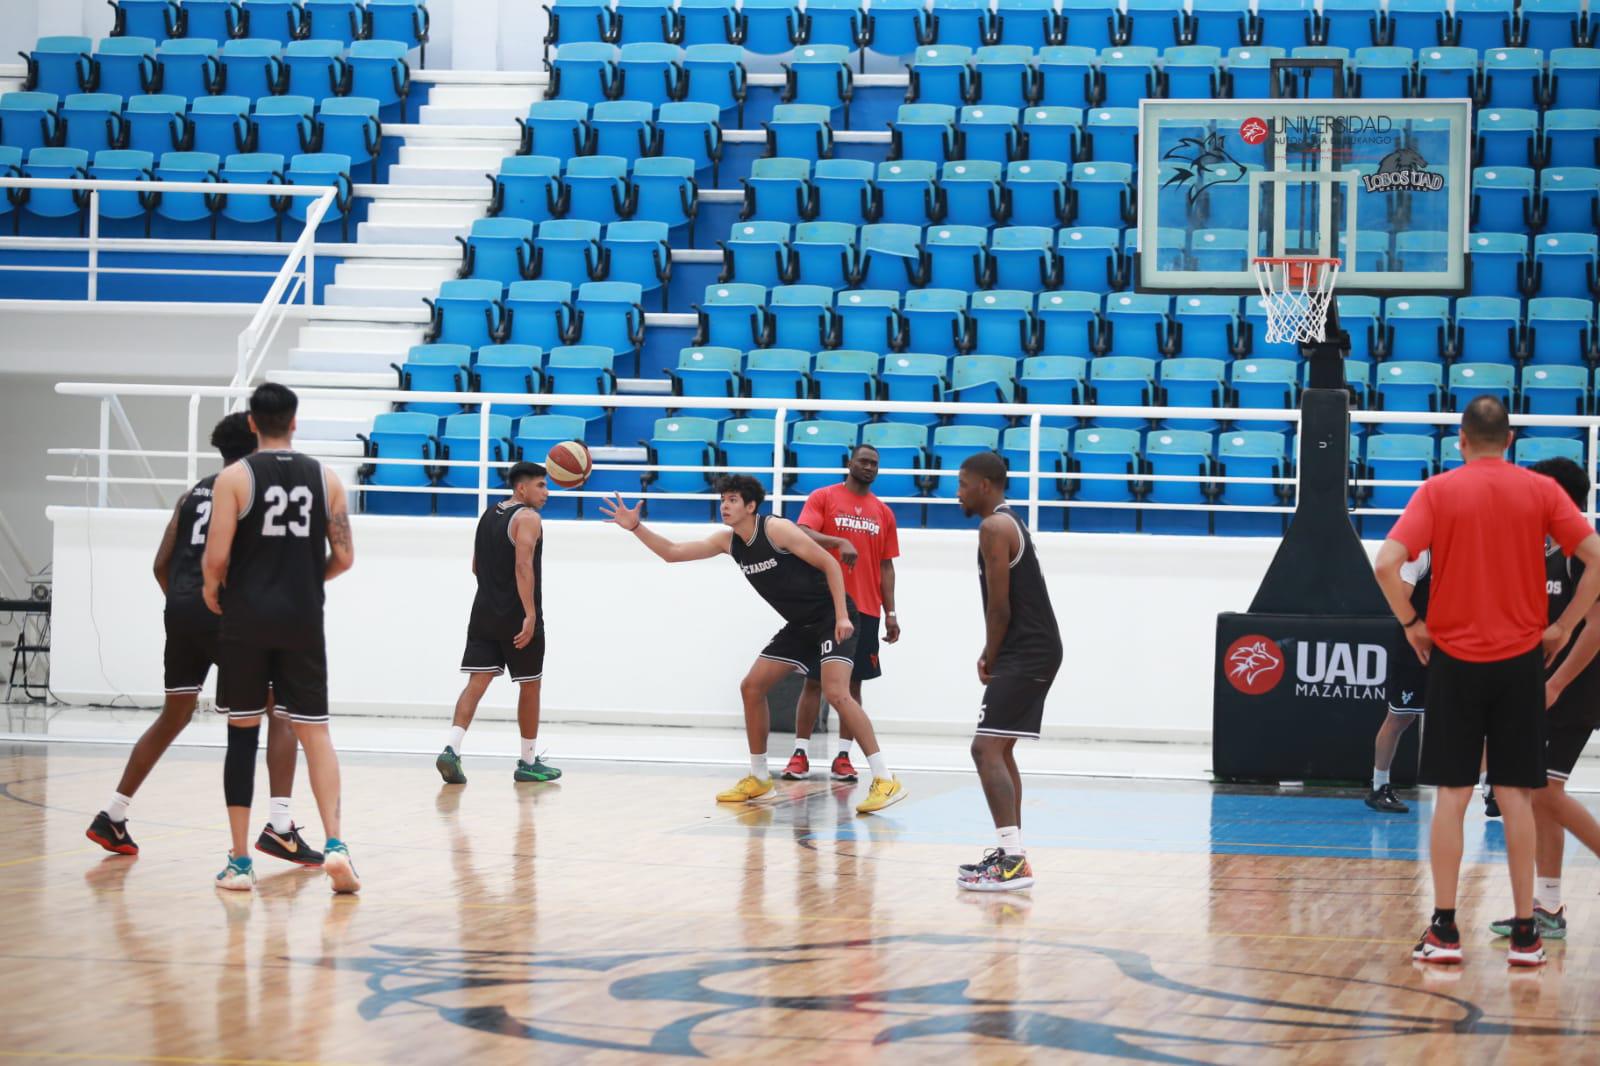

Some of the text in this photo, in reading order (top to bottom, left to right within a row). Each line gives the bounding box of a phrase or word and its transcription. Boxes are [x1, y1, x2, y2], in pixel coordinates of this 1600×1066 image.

[1273, 115, 1392, 134] UNIVERSIDAD
[1363, 170, 1444, 192] LOBOS UAD
[262, 486, 314, 537] 23
[834, 517, 880, 535] VENADOS
[1296, 641, 1388, 686] UAD
